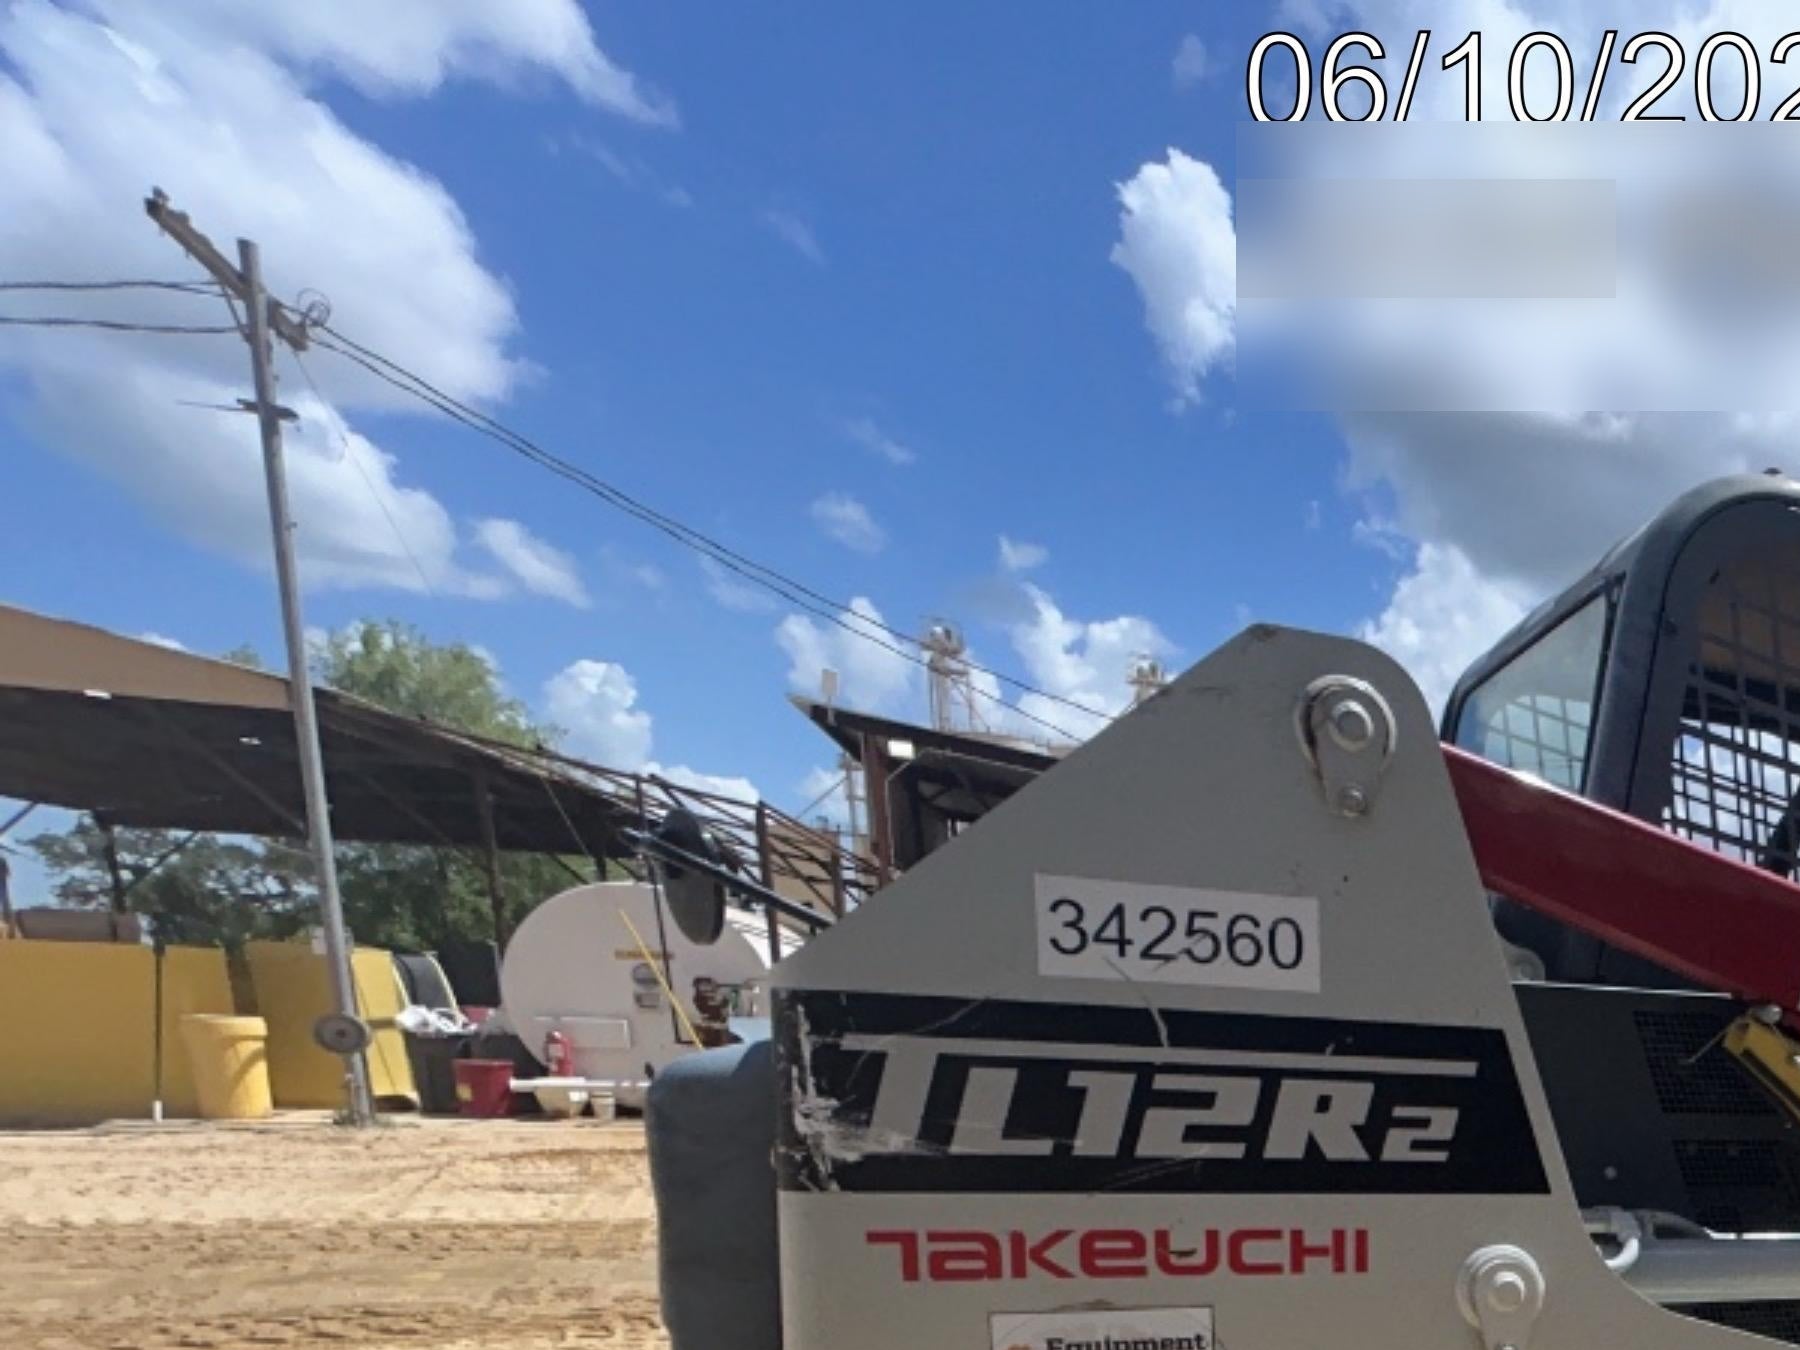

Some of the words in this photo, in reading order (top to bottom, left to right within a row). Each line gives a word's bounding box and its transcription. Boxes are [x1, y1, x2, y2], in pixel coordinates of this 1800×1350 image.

[1048, 897, 1304, 970] 342560
[840, 1034, 1478, 1163] TL12R2
[866, 1228, 1369, 1283] TAKEUCHI
